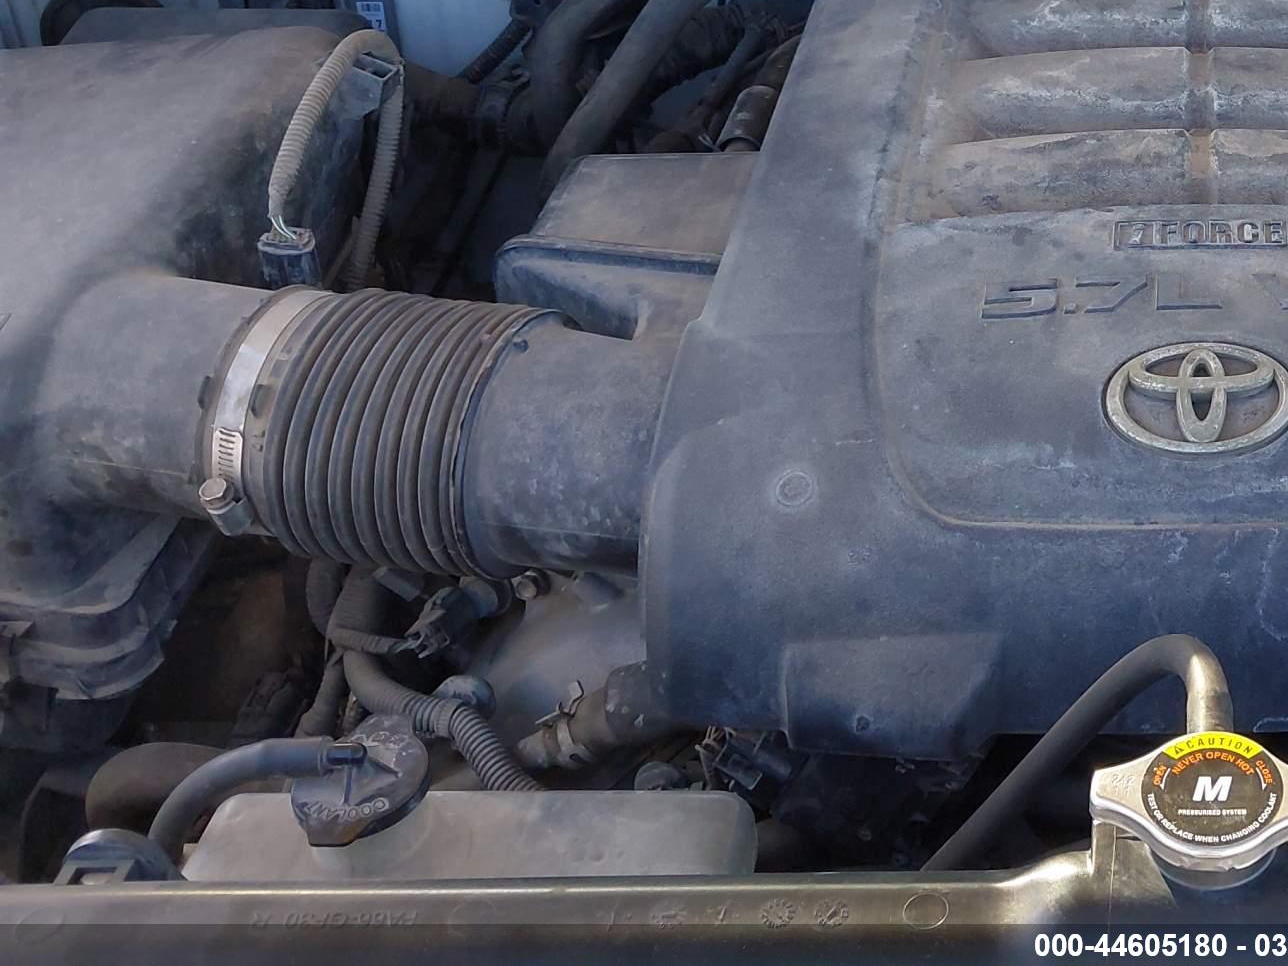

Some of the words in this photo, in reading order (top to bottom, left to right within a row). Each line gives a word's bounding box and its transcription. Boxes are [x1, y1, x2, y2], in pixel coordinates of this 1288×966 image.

[980, 273, 1223, 319] 5.7L
[1187, 737, 1253, 755] CAUTION
[1153, 765, 1168, 786] OPEN
[1171, 752, 1205, 776] NEVER
[1206, 751, 1235, 763] OPEN
[1235, 757, 1256, 776] HOT
[1255, 760, 1274, 785] CLOSE
[1192, 775, 1233, 802] M
[1147, 792, 1159, 811] TEST
[1153, 809, 1164, 822] OR
[1160, 817, 1194, 840] REPLACE
[1194, 834, 1220, 843] WHEN
[1220, 822, 1260, 843] CHANGING
[1257, 792, 1278, 823] COOLANT
[1222, 808, 1247, 816] SYSTEM
